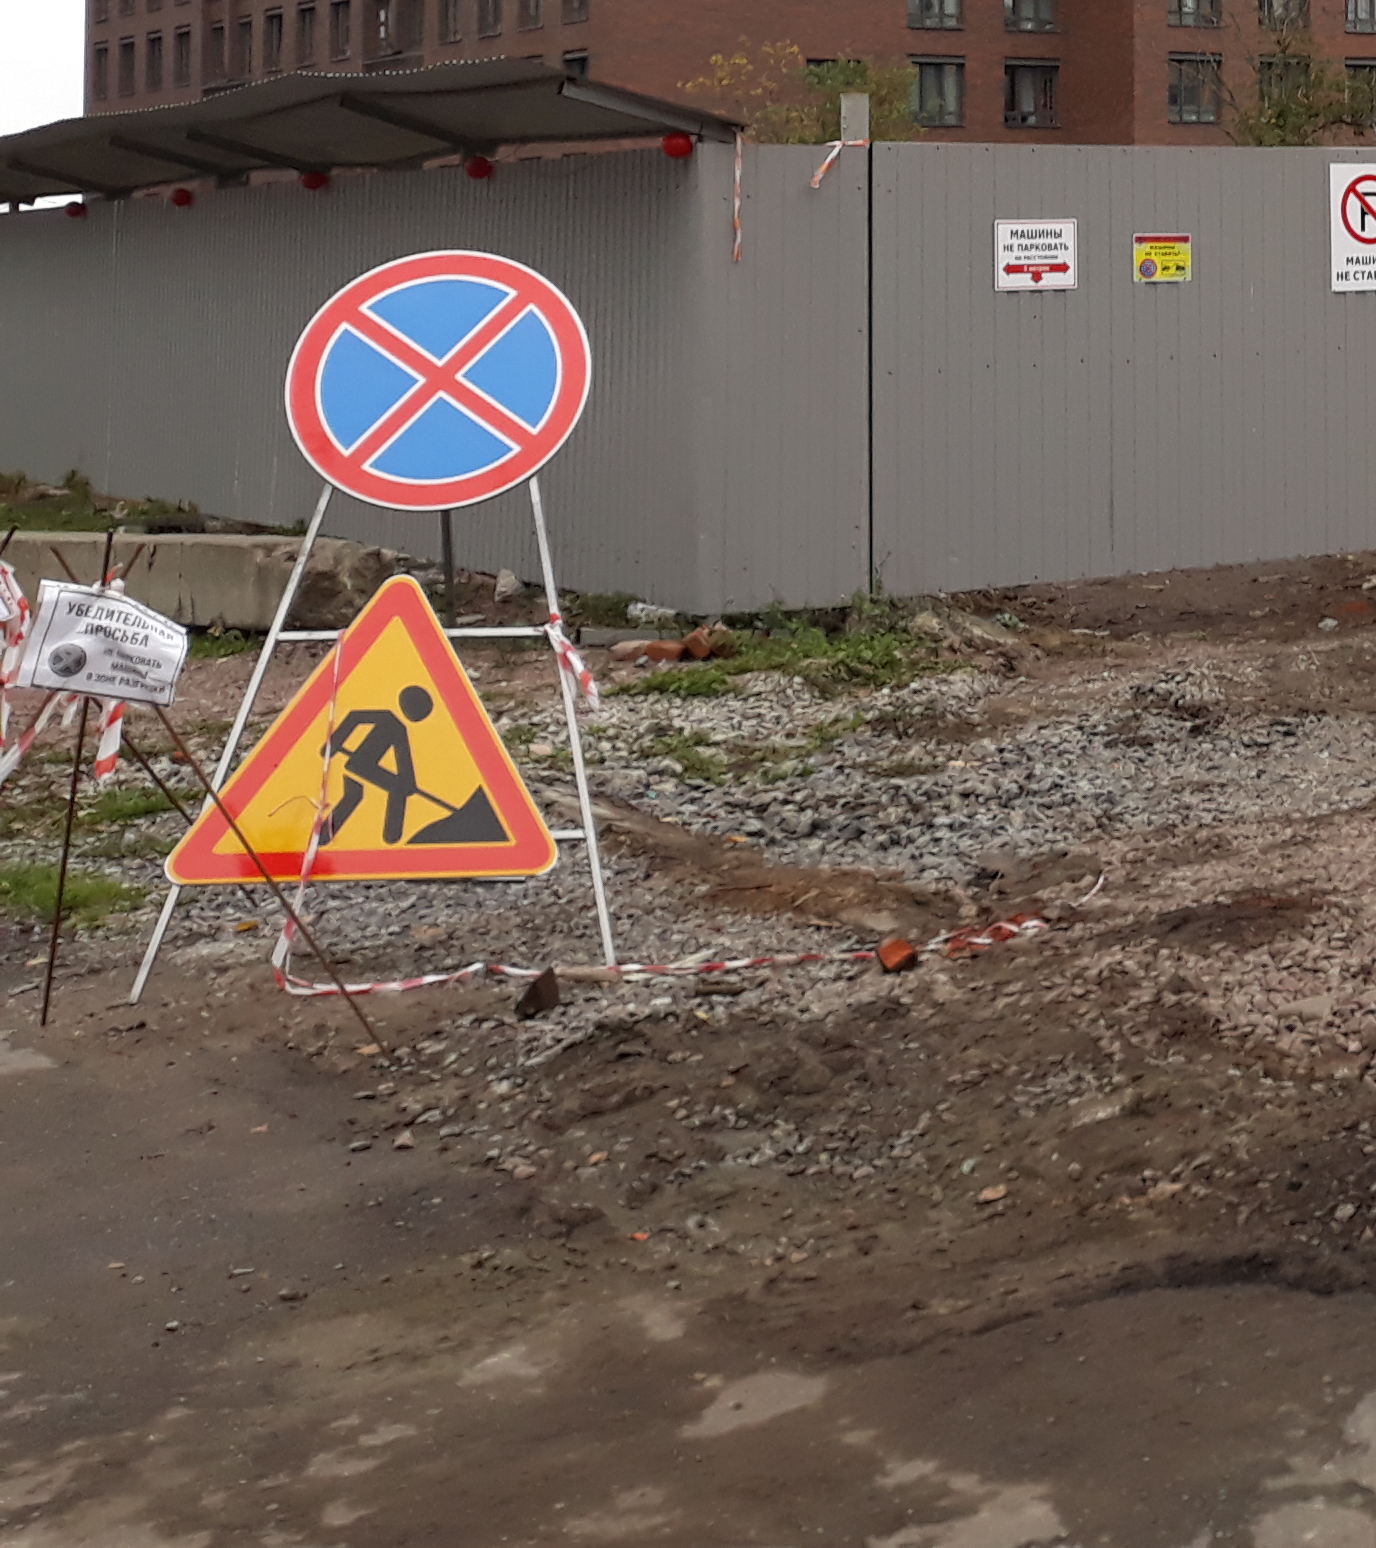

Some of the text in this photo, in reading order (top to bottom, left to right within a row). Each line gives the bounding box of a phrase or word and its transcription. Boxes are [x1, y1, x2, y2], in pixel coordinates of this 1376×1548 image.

[1010, 228, 1063, 240] МАШИНЫ
[1003, 242, 1069, 253] НЕ ПАРКОВАТЬ
[1336, 271, 1350, 282] НЕ
[84, 623, 149, 647] ПРОСЬБА
